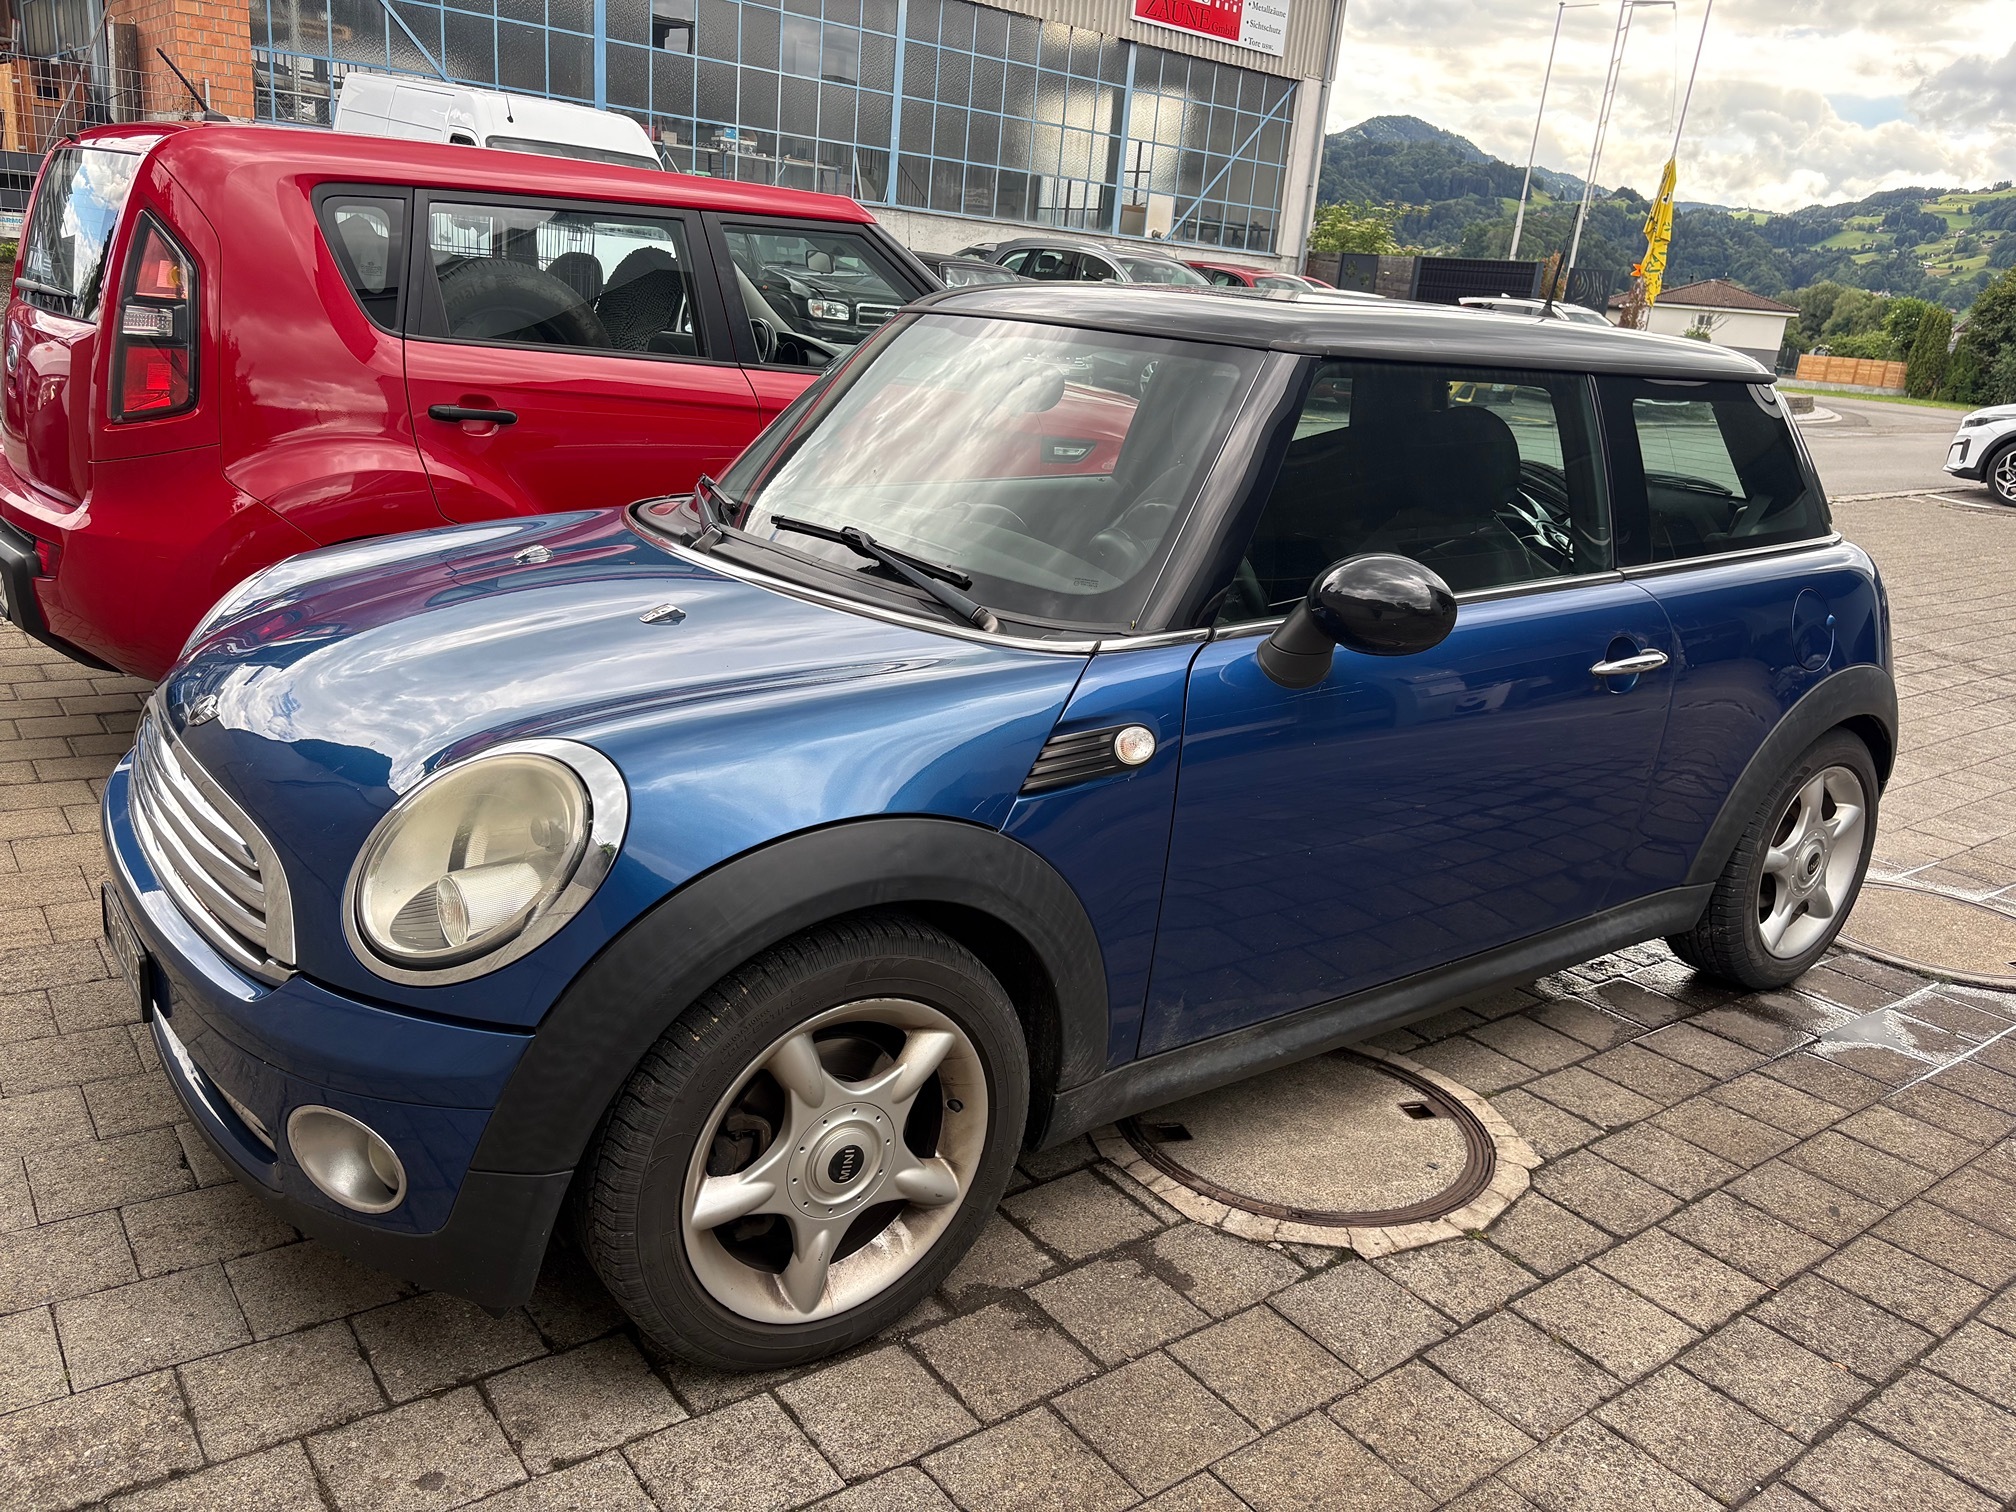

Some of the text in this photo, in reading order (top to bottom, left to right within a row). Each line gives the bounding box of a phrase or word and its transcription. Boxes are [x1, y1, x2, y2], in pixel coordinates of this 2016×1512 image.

[1252, 1, 1287, 18] Metallzäune
[1212, 22, 1237, 37] GmbH
[1249, 19, 1282, 35] Sichtschutz
[1248, 37, 1261, 47] Tore
[839, 1149, 855, 1180] MINI
